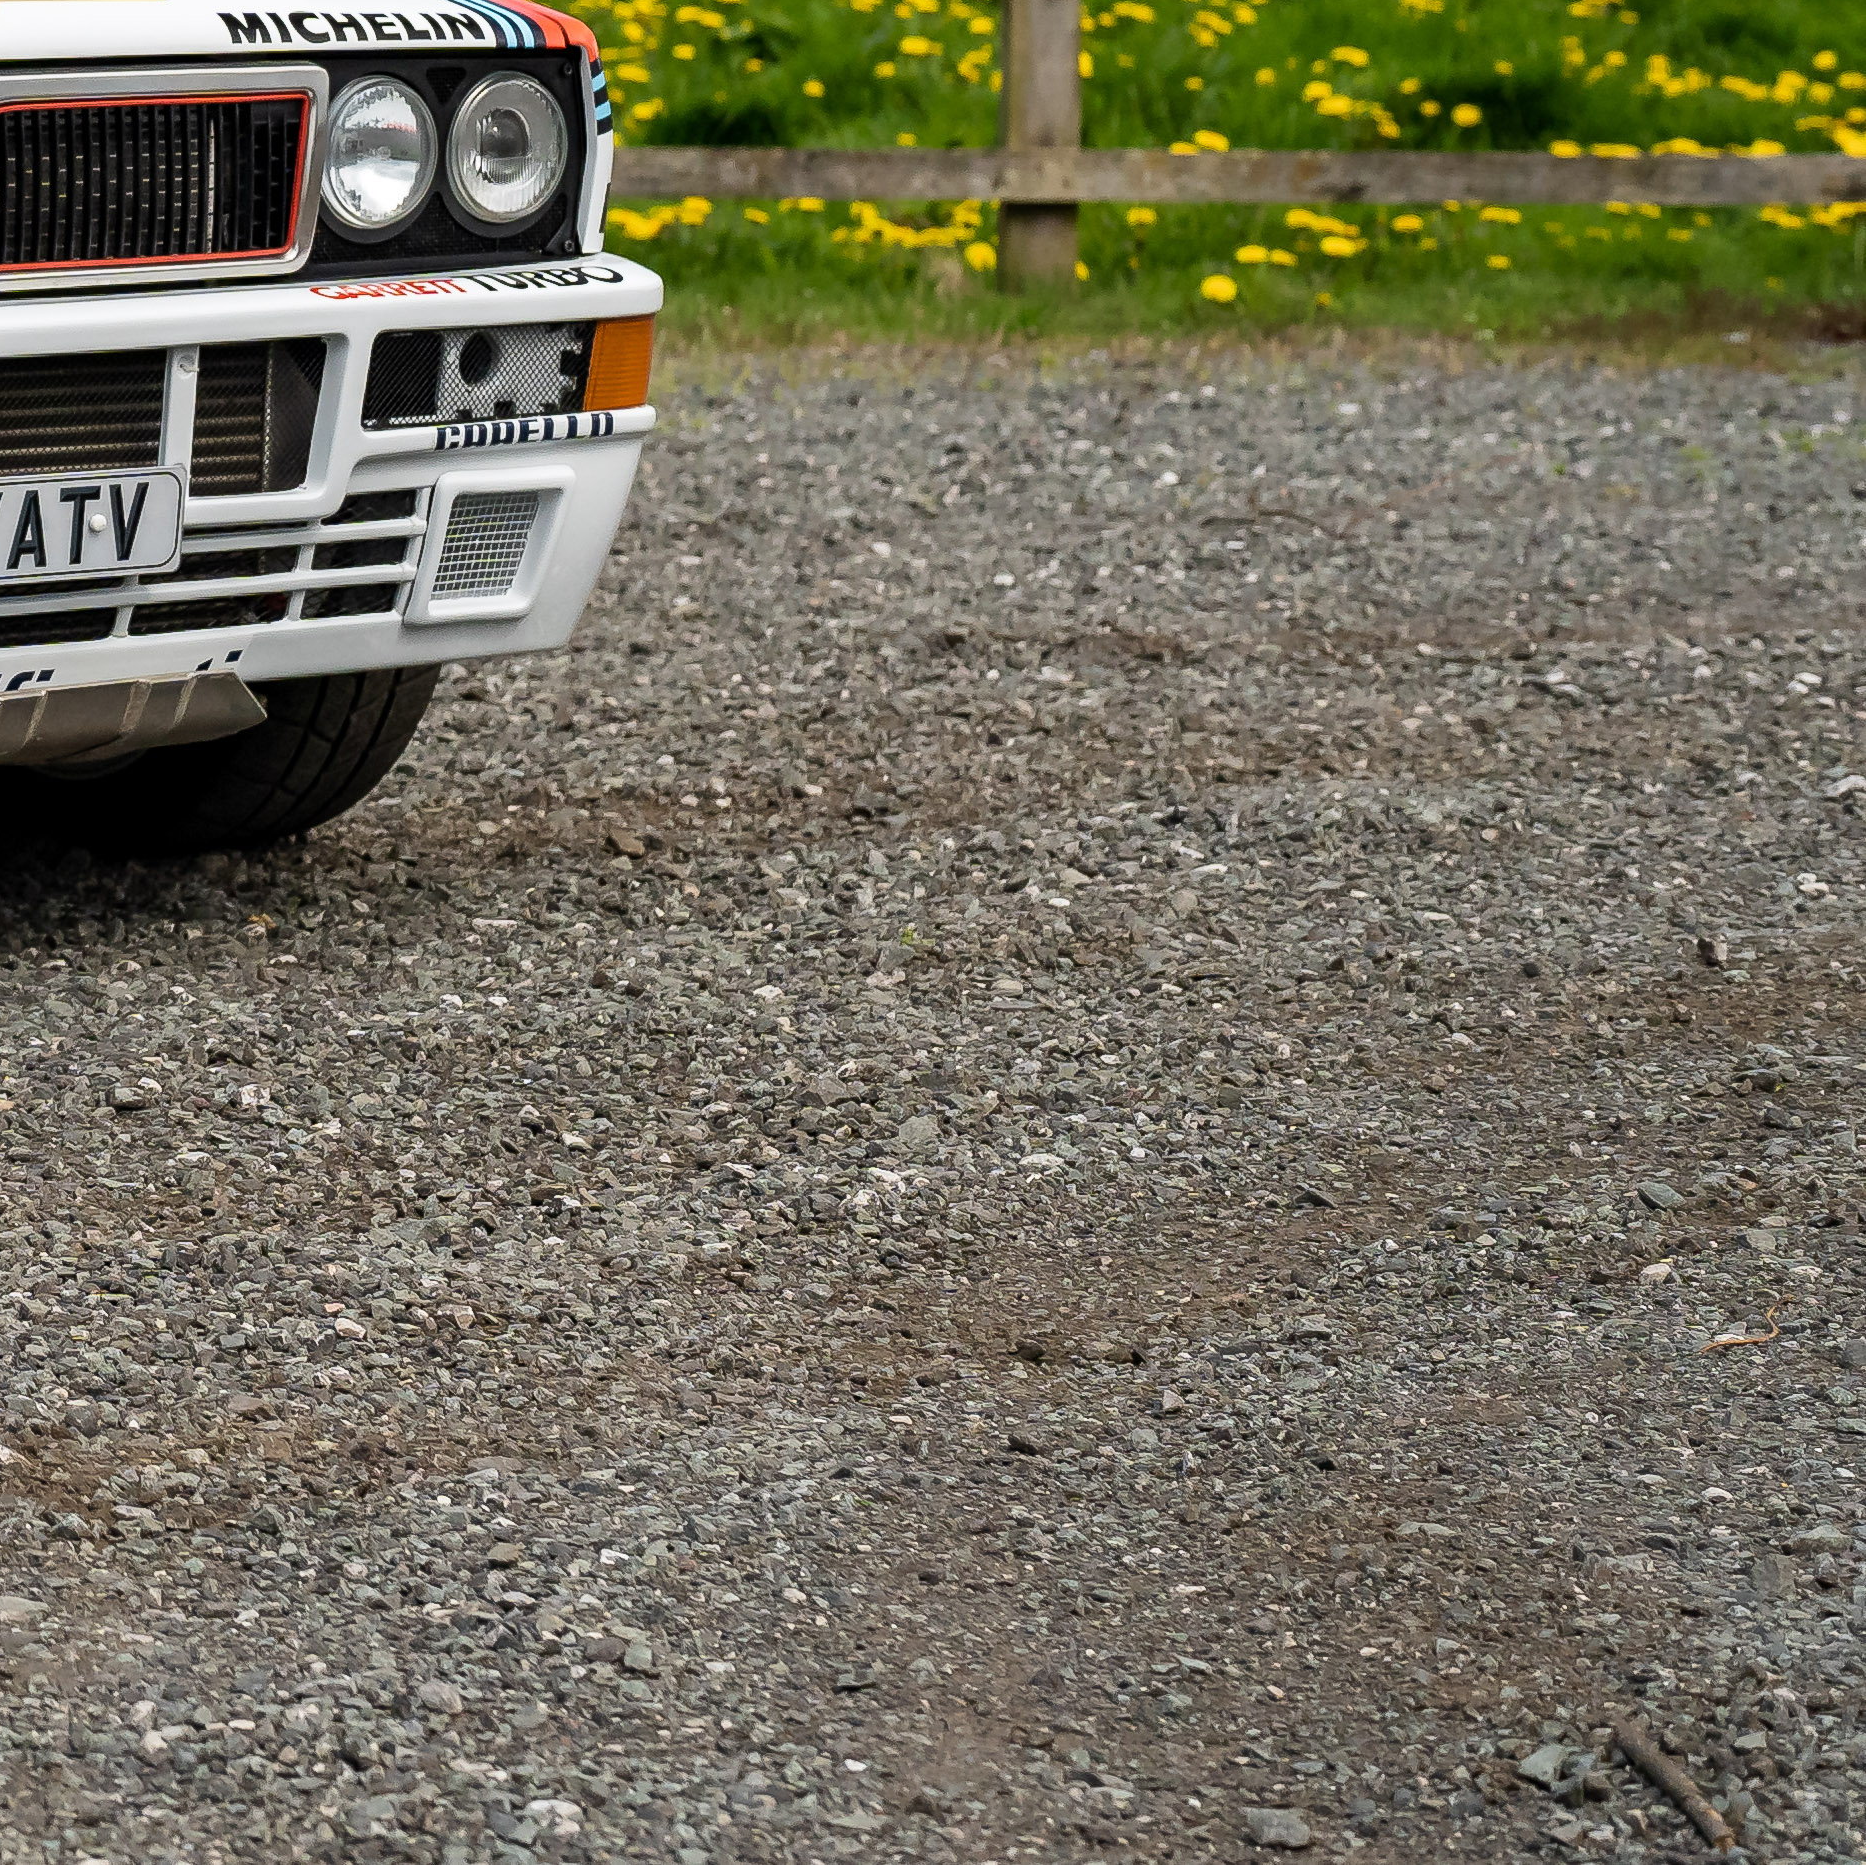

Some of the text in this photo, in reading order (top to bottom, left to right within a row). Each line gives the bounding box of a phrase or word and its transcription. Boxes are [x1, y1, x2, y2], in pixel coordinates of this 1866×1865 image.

[216, 11, 486, 44] MICHELIN
[310, 265, 624, 300] GARRETT TURBO
